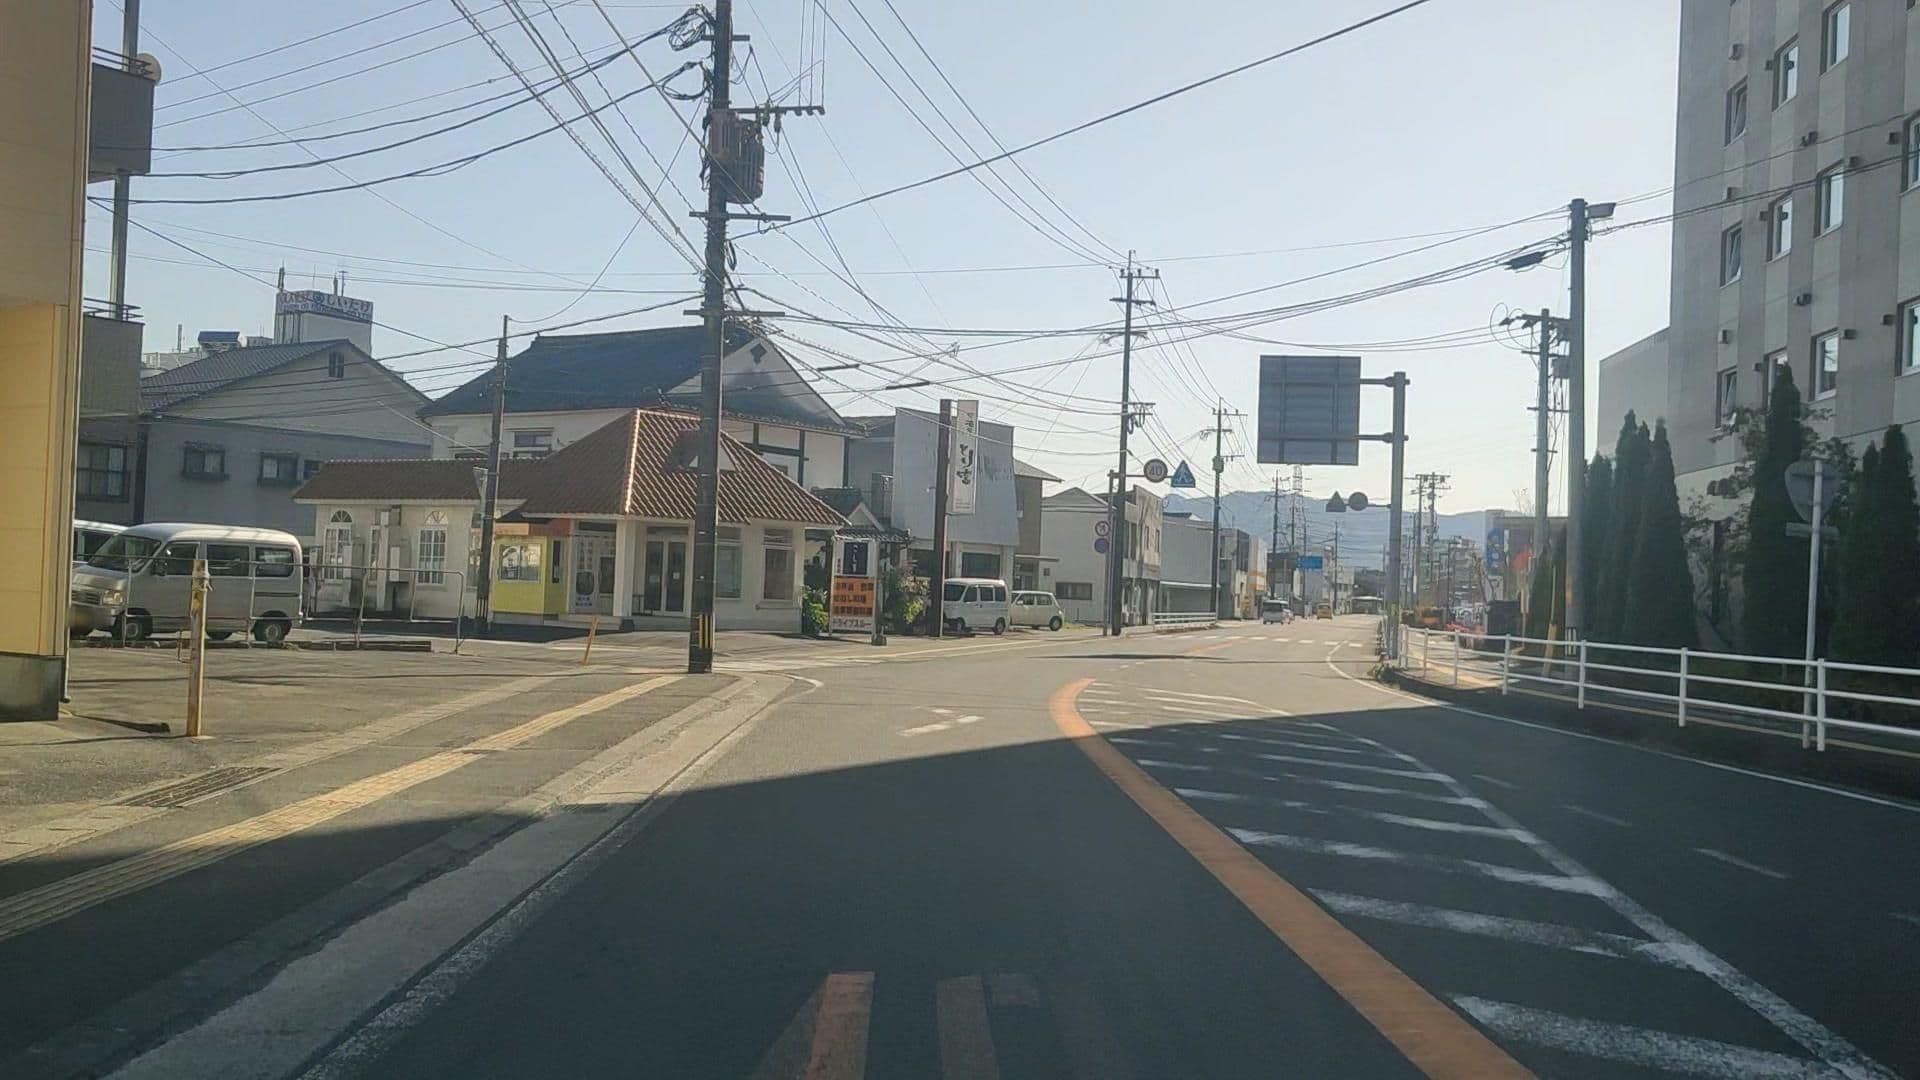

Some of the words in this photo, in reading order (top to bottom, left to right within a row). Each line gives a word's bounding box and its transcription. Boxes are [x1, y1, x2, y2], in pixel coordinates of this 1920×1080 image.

[1149, 463, 1163, 476] 40
[833, 618, 872, 628] ドライブスルー
